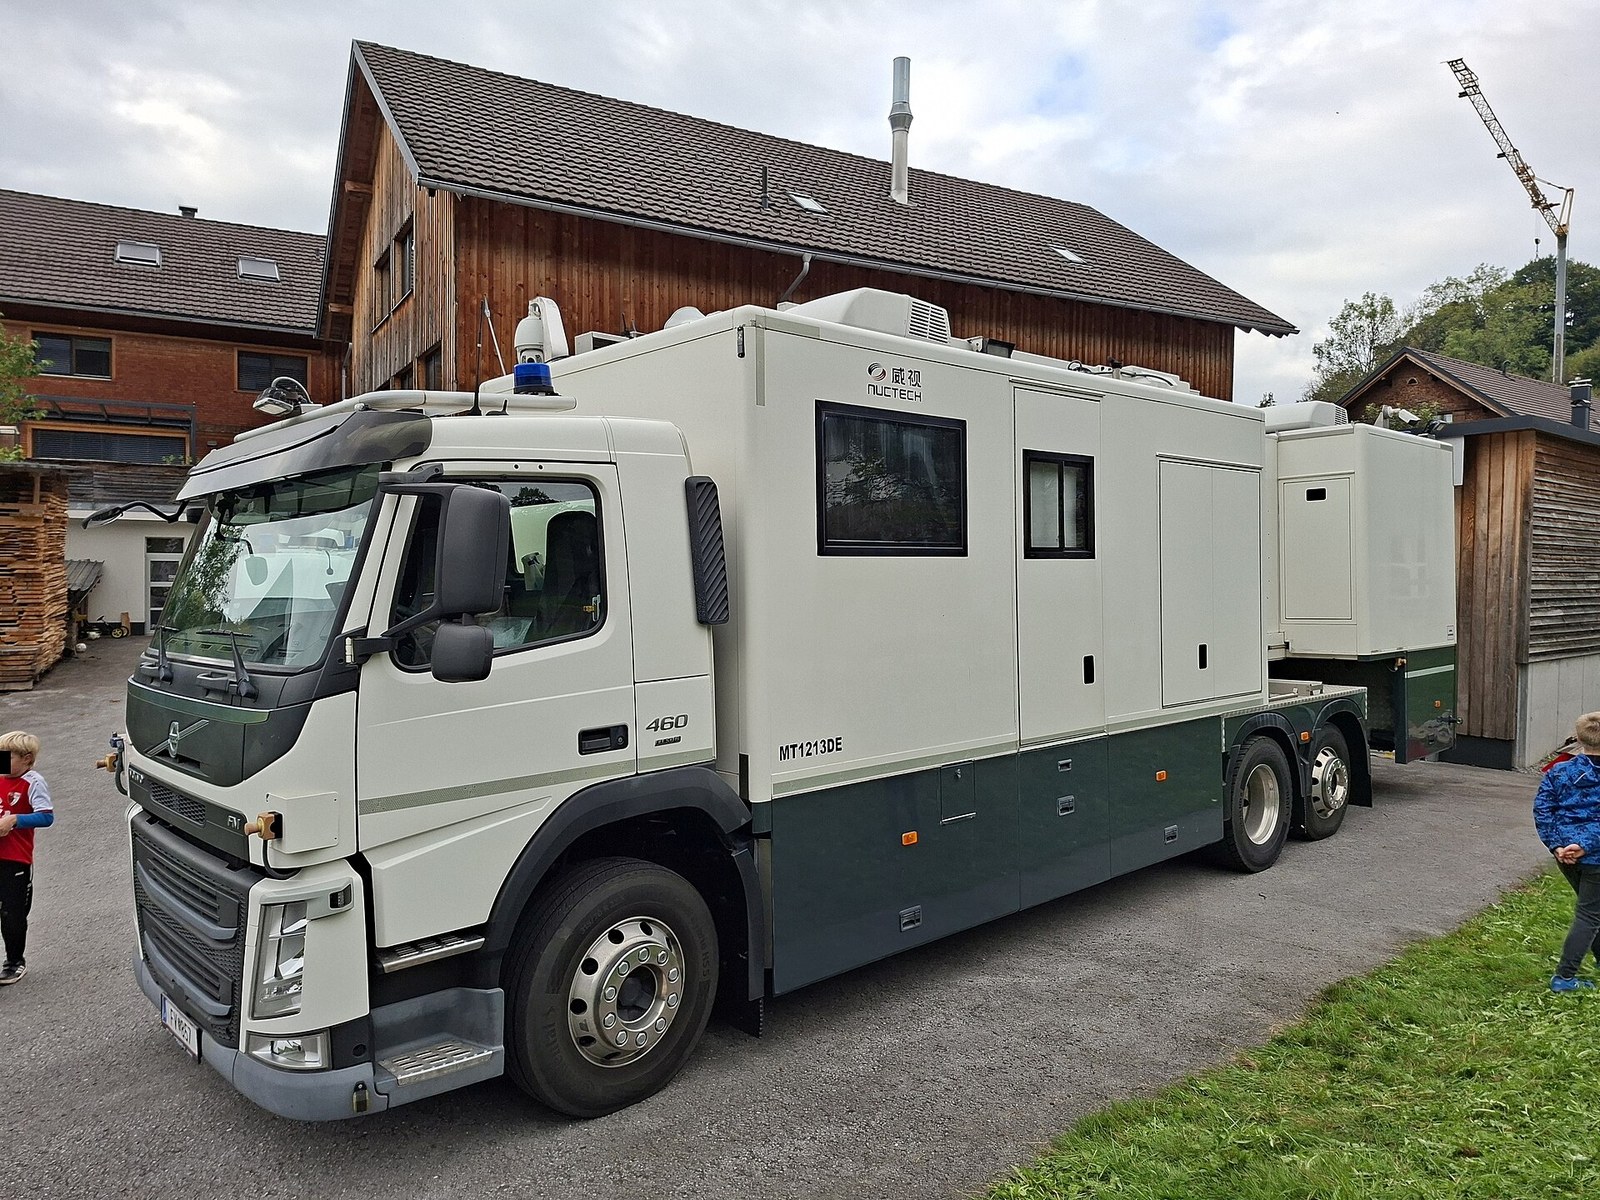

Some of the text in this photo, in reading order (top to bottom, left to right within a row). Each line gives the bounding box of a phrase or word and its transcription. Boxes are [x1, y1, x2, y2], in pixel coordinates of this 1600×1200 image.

[891, 367, 922, 388] 威视
[867, 383, 922, 403] NUCTECH
[645, 714, 689, 732] 460
[779, 736, 843, 761] MT1213DE
